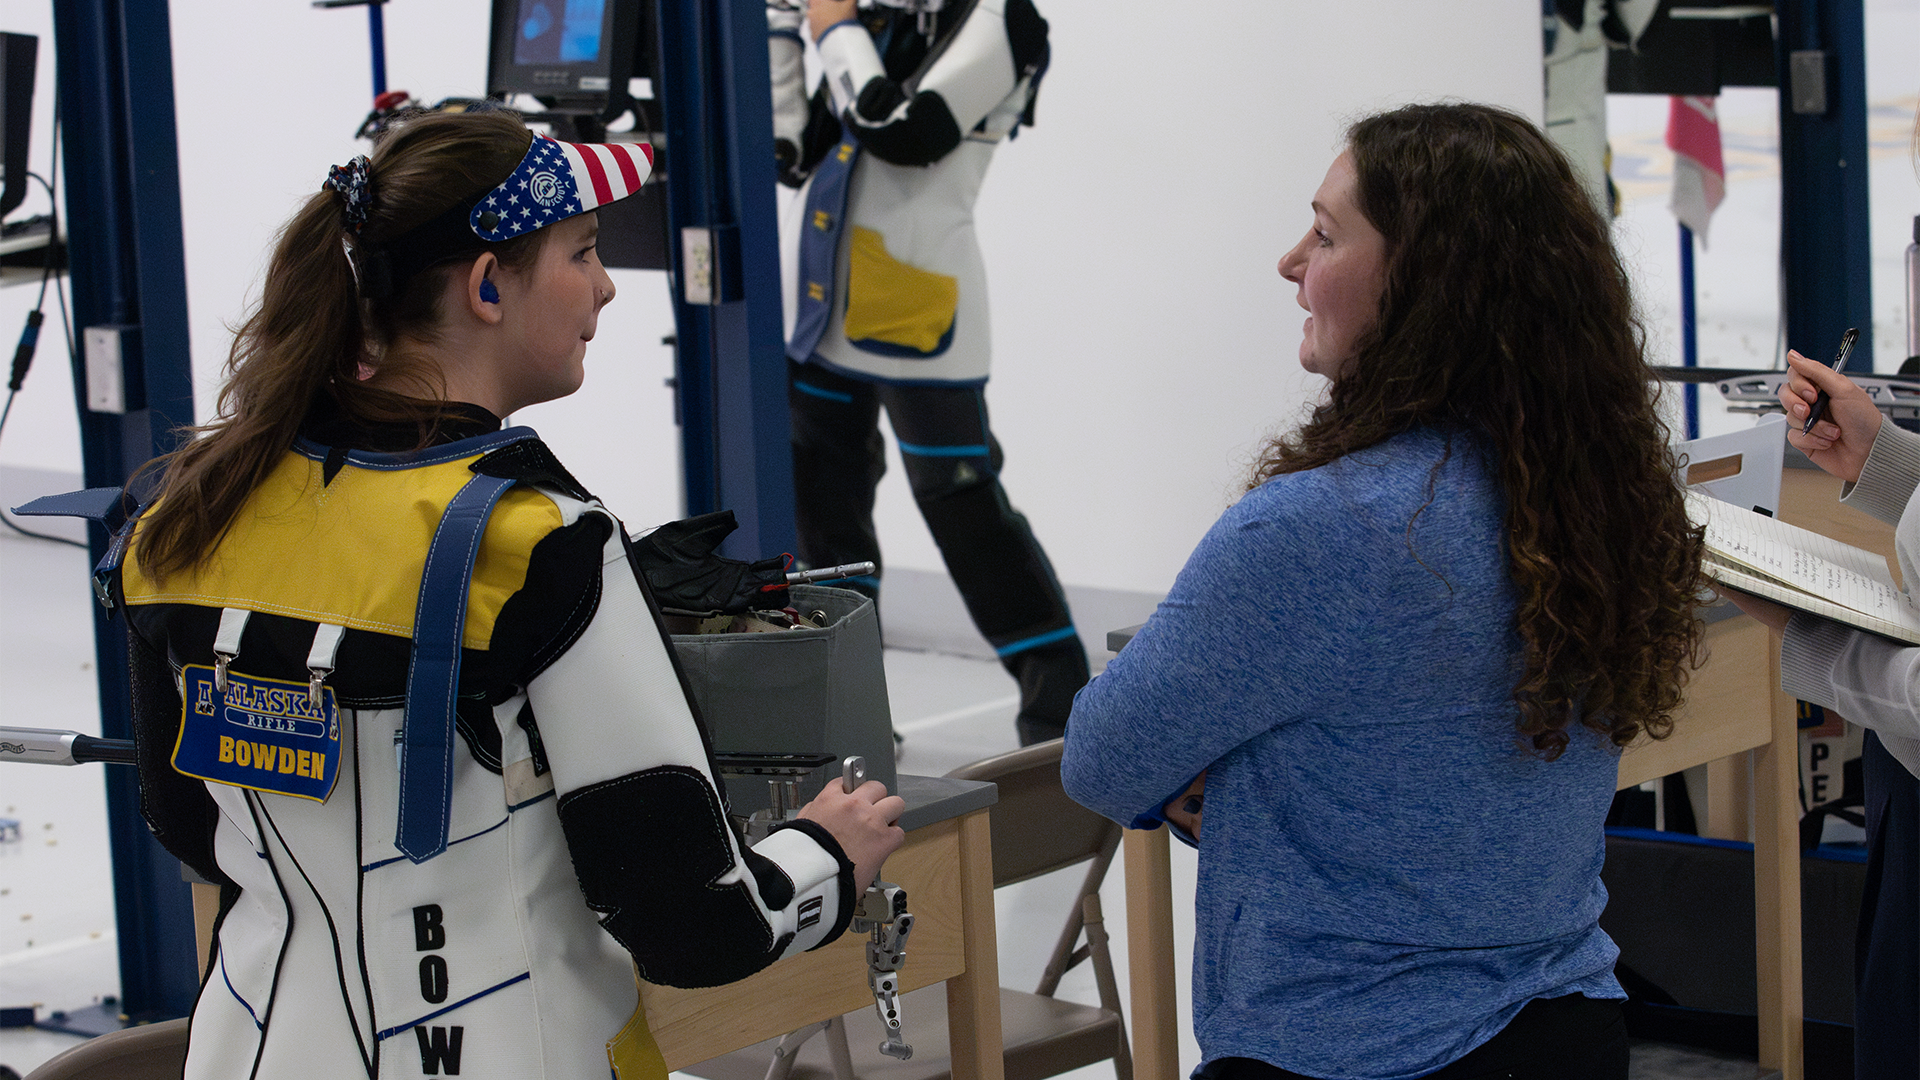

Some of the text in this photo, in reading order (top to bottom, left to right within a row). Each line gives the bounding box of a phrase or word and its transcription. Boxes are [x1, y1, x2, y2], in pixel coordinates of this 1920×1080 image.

[224, 680, 325, 721] ALASKA
[247, 714, 296, 732] RIFLE
[218, 735, 325, 780] BOWDEN
[412, 904, 464, 1080] BOW
